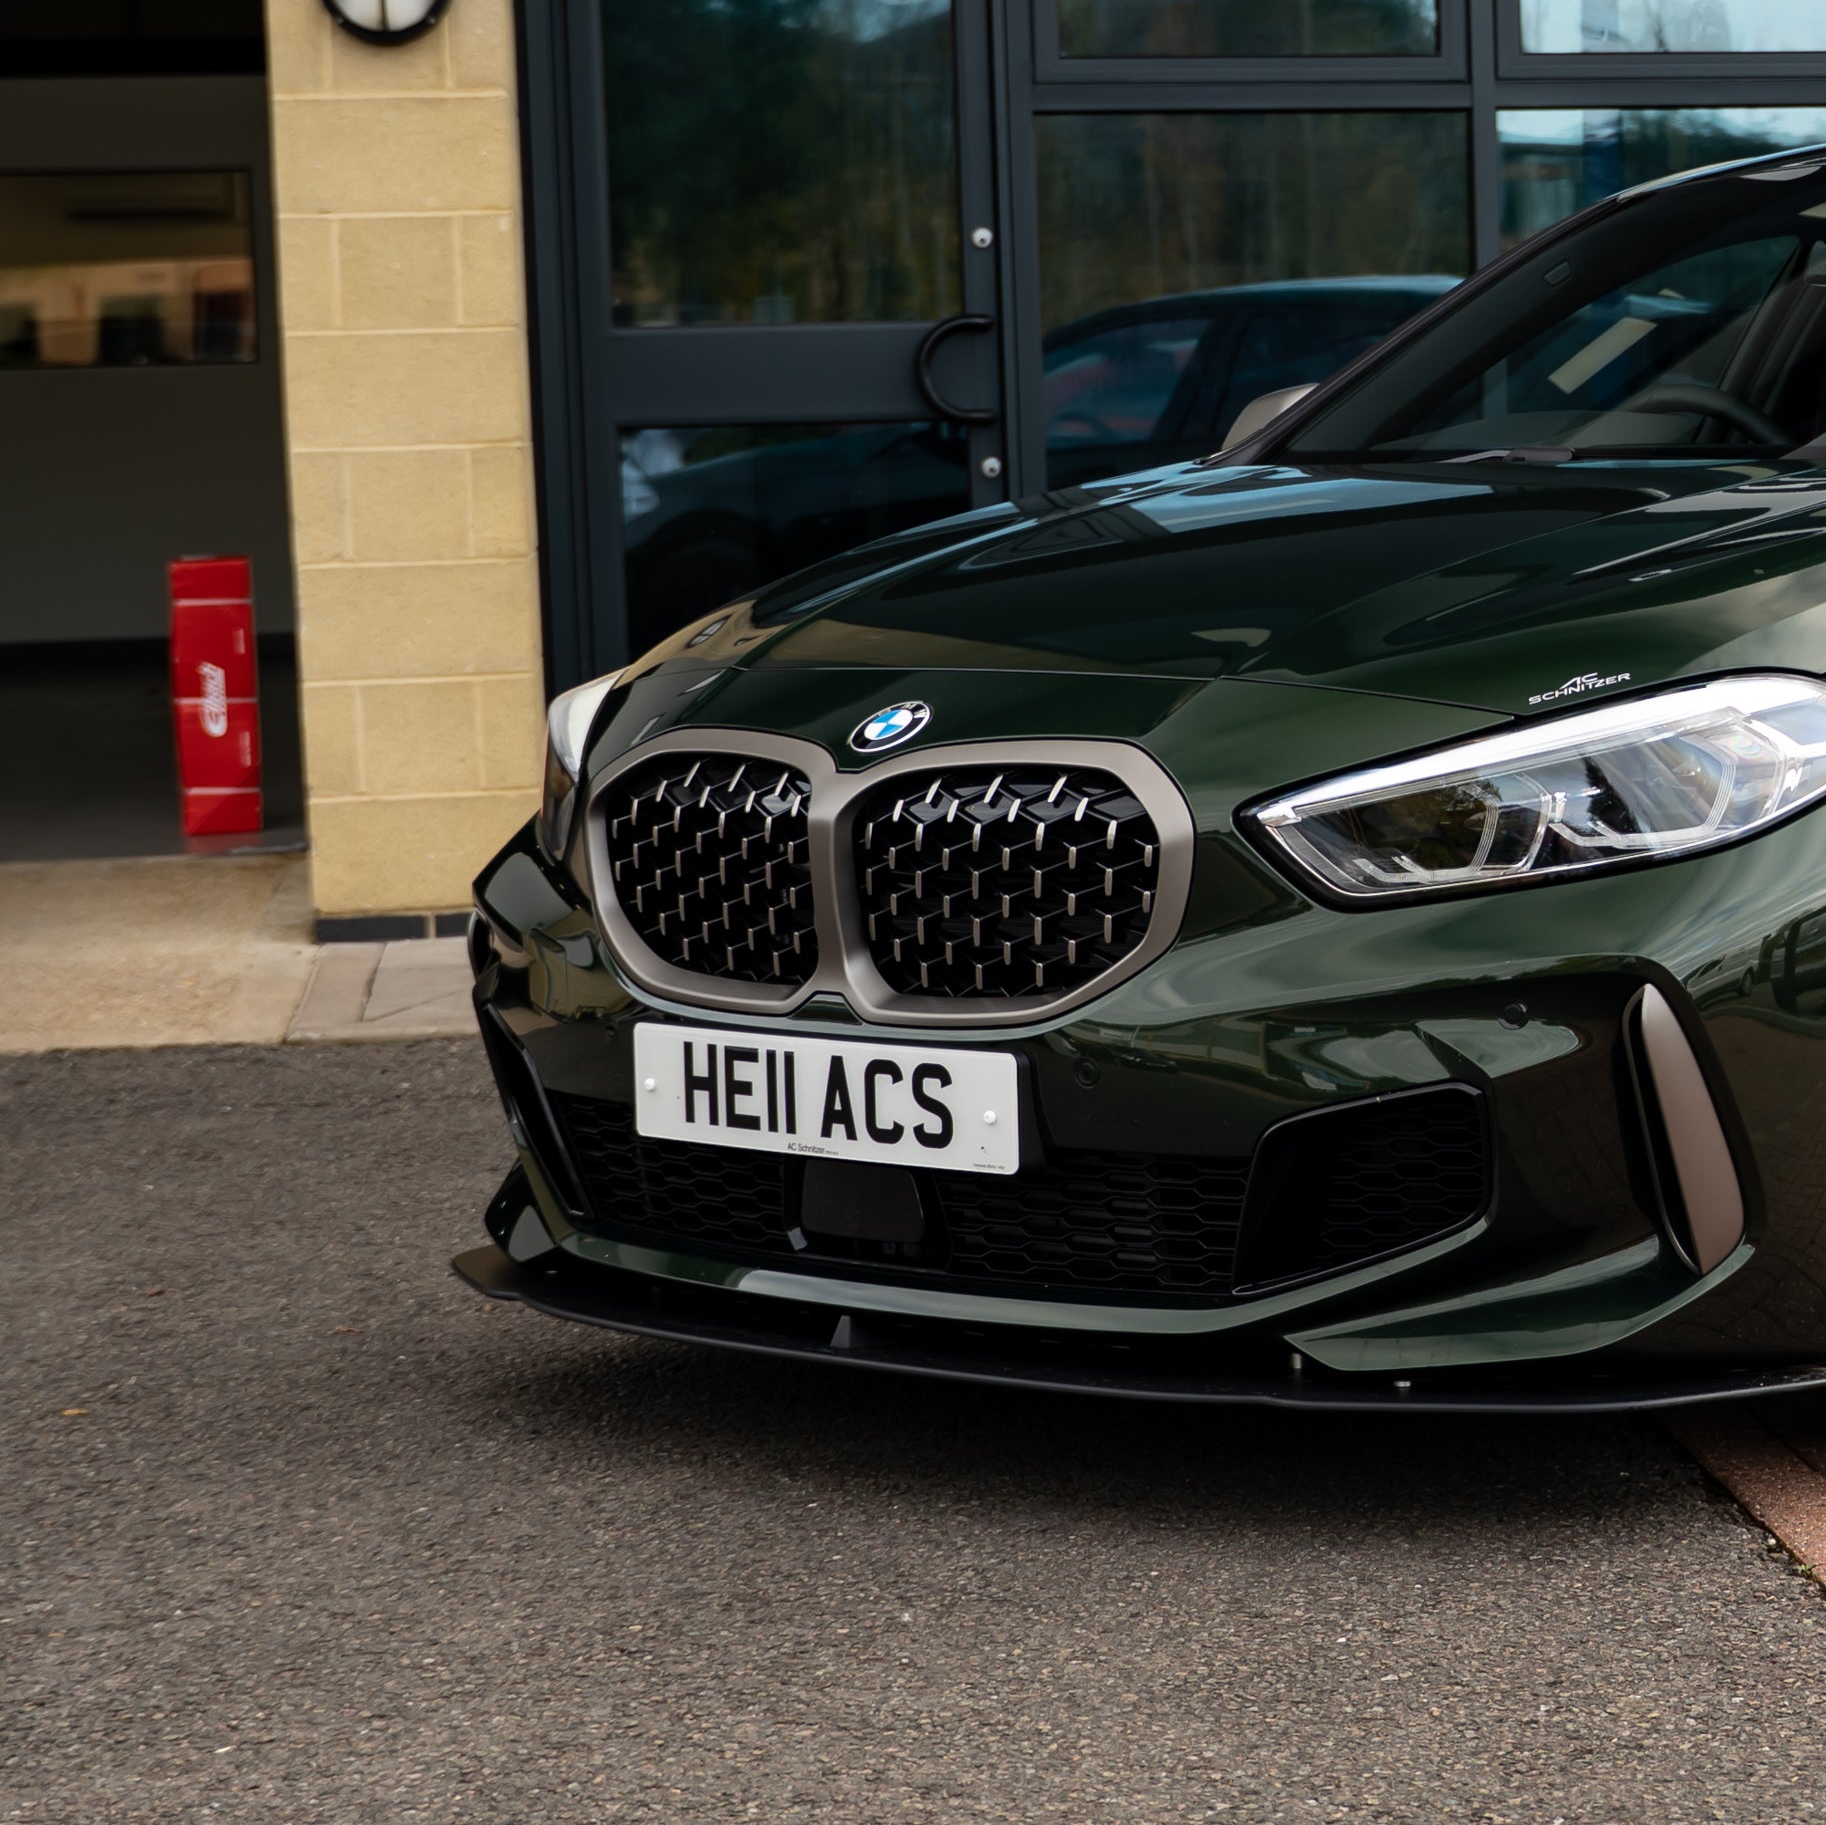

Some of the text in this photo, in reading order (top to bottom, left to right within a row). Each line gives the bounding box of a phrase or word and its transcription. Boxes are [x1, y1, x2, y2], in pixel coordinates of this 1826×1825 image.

[1528, 672, 1632, 705] SCHNITZER
[1558, 672, 1598, 690] AC
[821, 1055, 954, 1149] ACS
[787, 1142, 797, 1151] AC
[798, 1144, 826, 1154] Schnitzer
